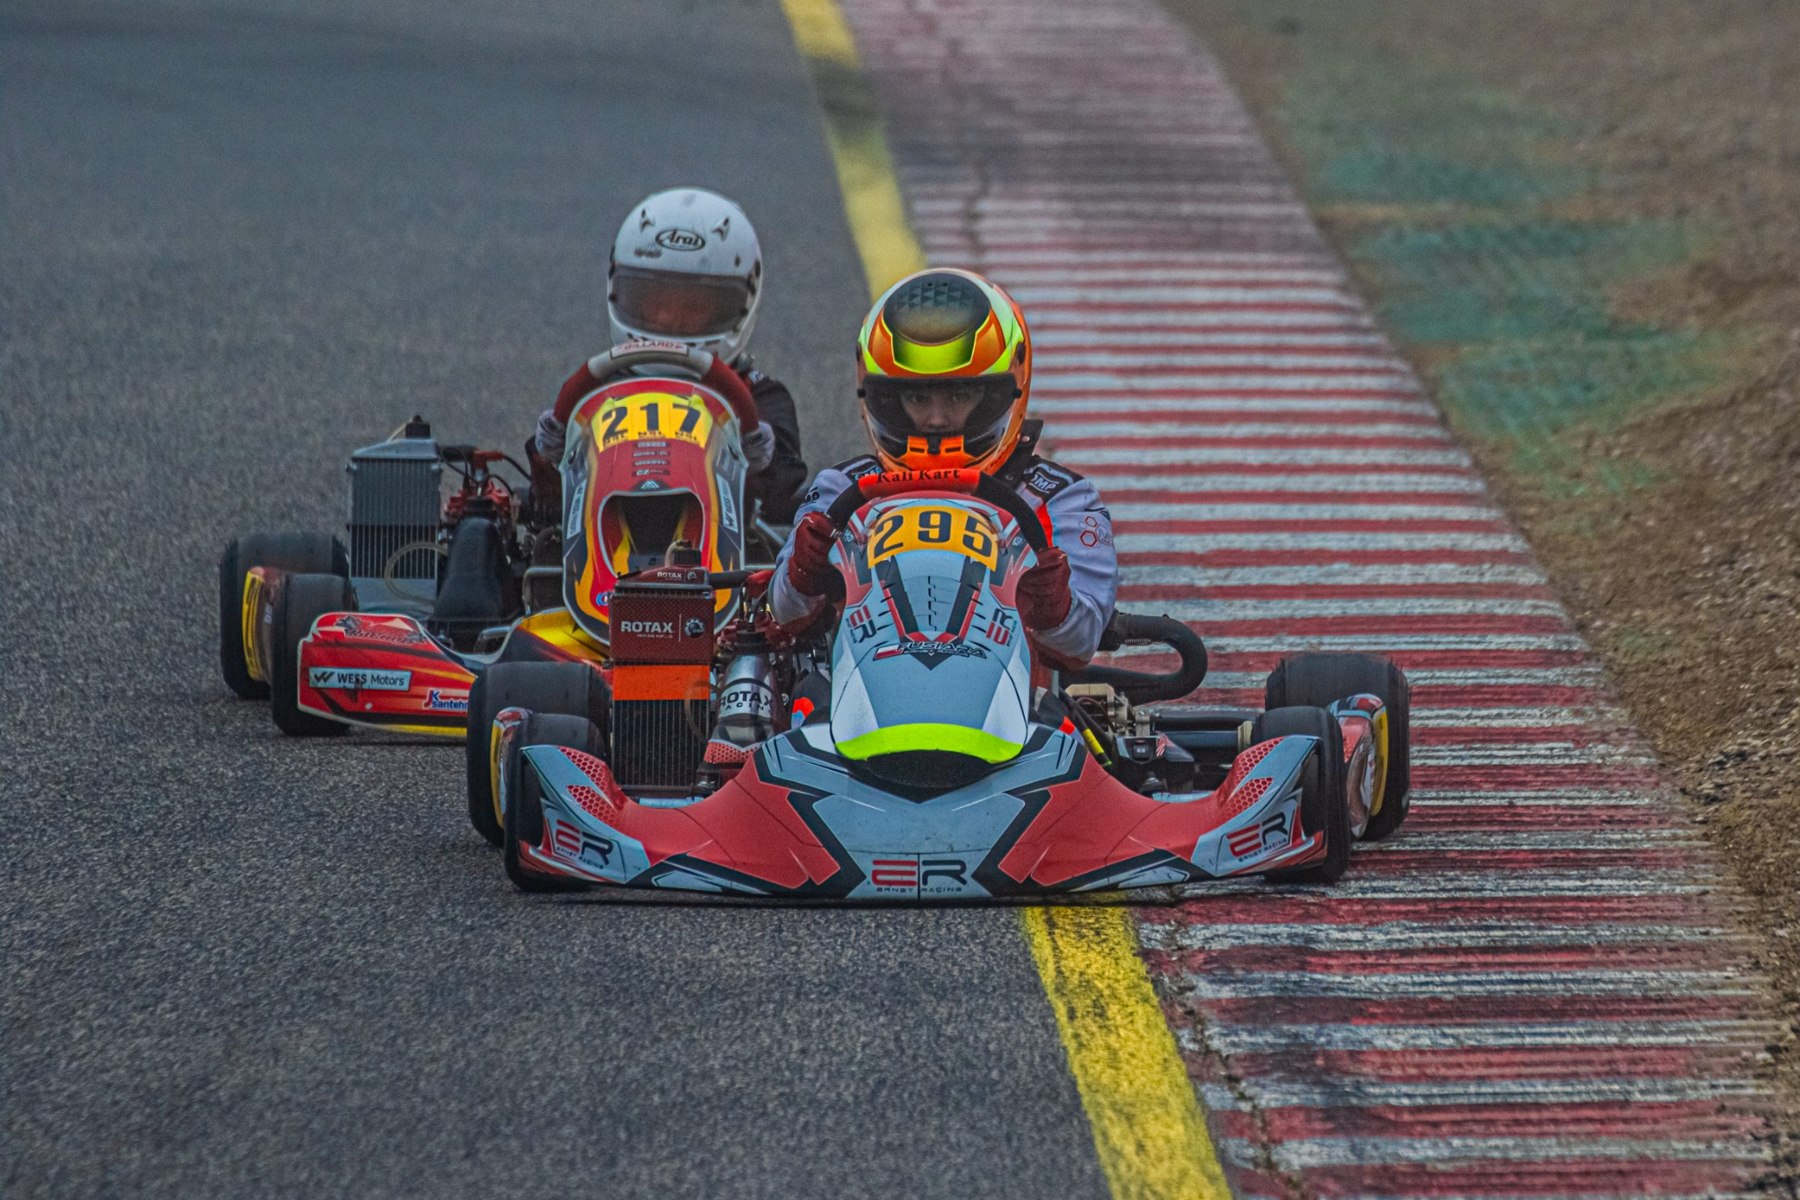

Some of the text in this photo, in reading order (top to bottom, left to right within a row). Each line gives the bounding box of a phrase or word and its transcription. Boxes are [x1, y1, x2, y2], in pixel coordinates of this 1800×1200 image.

[665, 229, 700, 247] Arai
[602, 402, 701, 441] 217
[877, 470, 913, 483] Kali
[919, 469, 961, 481] Kart
[873, 510, 992, 559] 295
[657, 571, 682, 579] ROTAX
[621, 621, 674, 634] ROTAX
[337, 672, 404, 686] WESS Motors
[556, 819, 614, 865] ER
[1226, 812, 1289, 857] ER
[871, 859, 968, 886] ER
